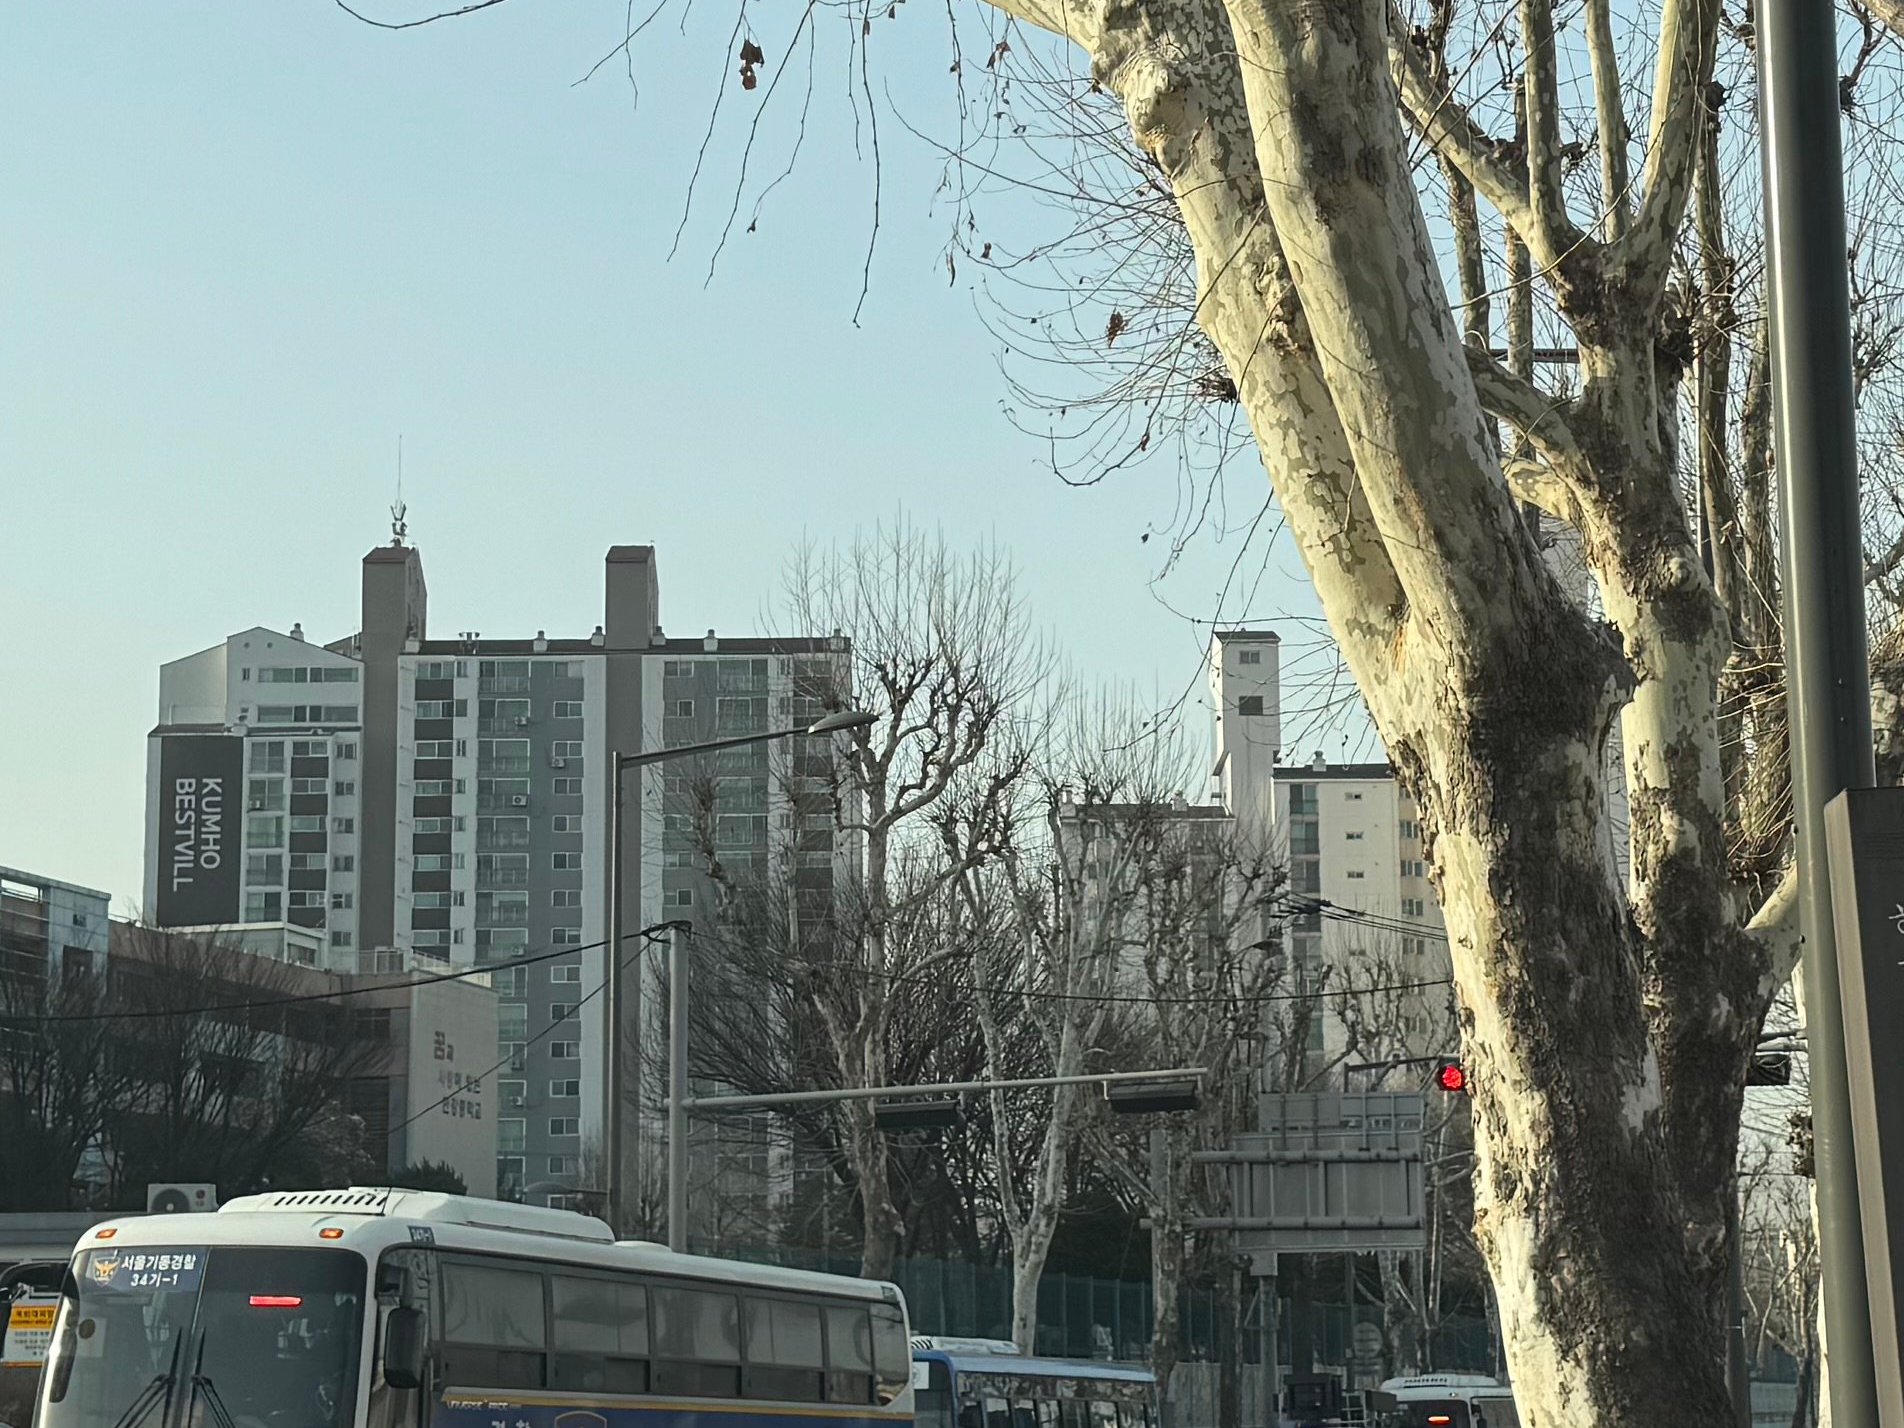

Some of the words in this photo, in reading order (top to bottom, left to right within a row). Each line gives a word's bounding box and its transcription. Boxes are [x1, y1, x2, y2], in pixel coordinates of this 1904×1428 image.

[173, 778, 196, 892] BESTVILL
[200, 778, 222, 869] KUMHO
[121, 1254, 197, 1271] 서울기동경찰
[130, 1272, 179, 1288] 34기-1
